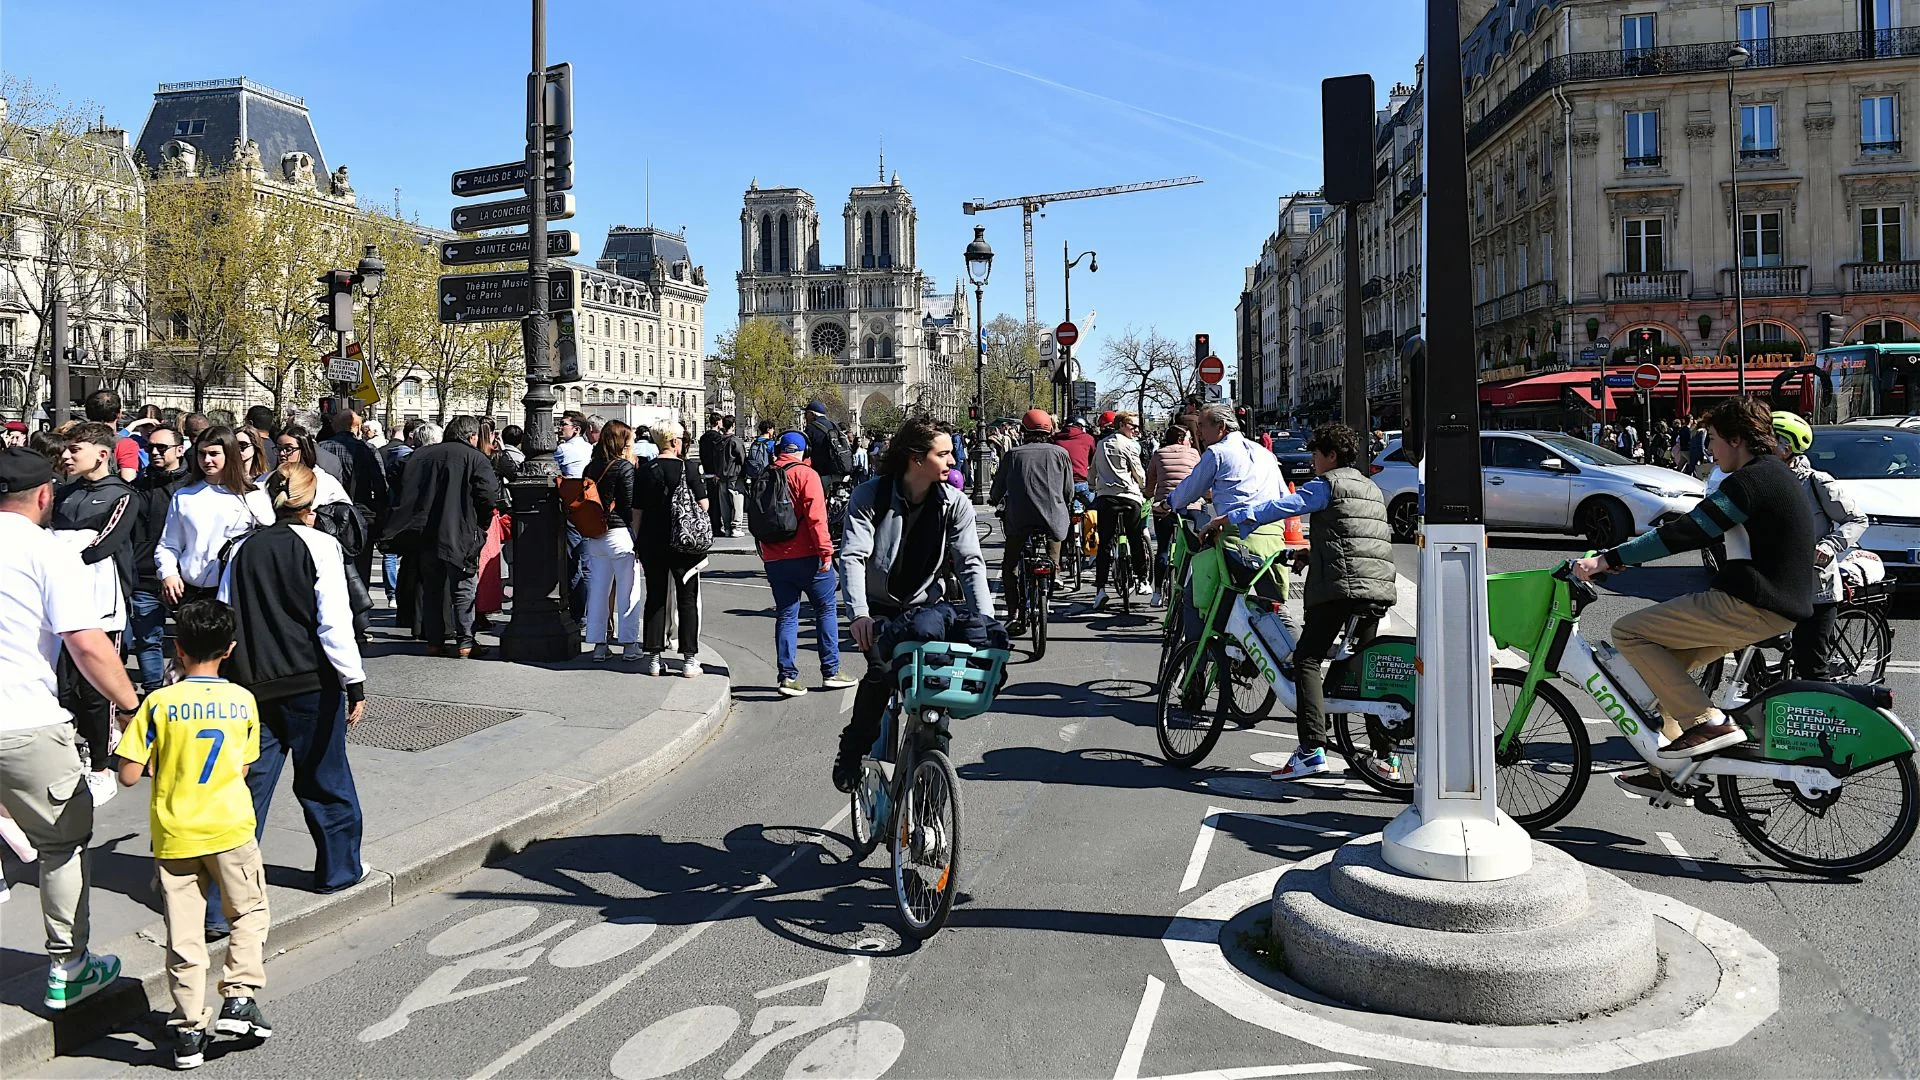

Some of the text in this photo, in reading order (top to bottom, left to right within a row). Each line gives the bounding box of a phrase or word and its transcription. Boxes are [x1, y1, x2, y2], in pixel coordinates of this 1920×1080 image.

[473, 169, 529, 185] PALAIS DE JUS
[480, 205, 531, 221] LA CONCIERG
[475, 243, 506, 254] SAINTE
[465, 278, 529, 291] Théâtre Music
[465, 290, 502, 300] de Paris
[466, 303, 524, 315] Théâtre de la
[1659, 356, 1675, 370] LE
[1749, 353, 1793, 368] SAINT
[1243, 631, 1276, 684] Lime
[1586, 672, 1639, 736] Lime
[1787, 706, 1827, 717] PRÊTS,
[168, 702, 248, 722] RONALDO
[1786, 714, 1846, 726] ATTENDEZ
[1786, 721, 1861, 736] LE FEU VERT,
[196, 728, 225, 785] 7
